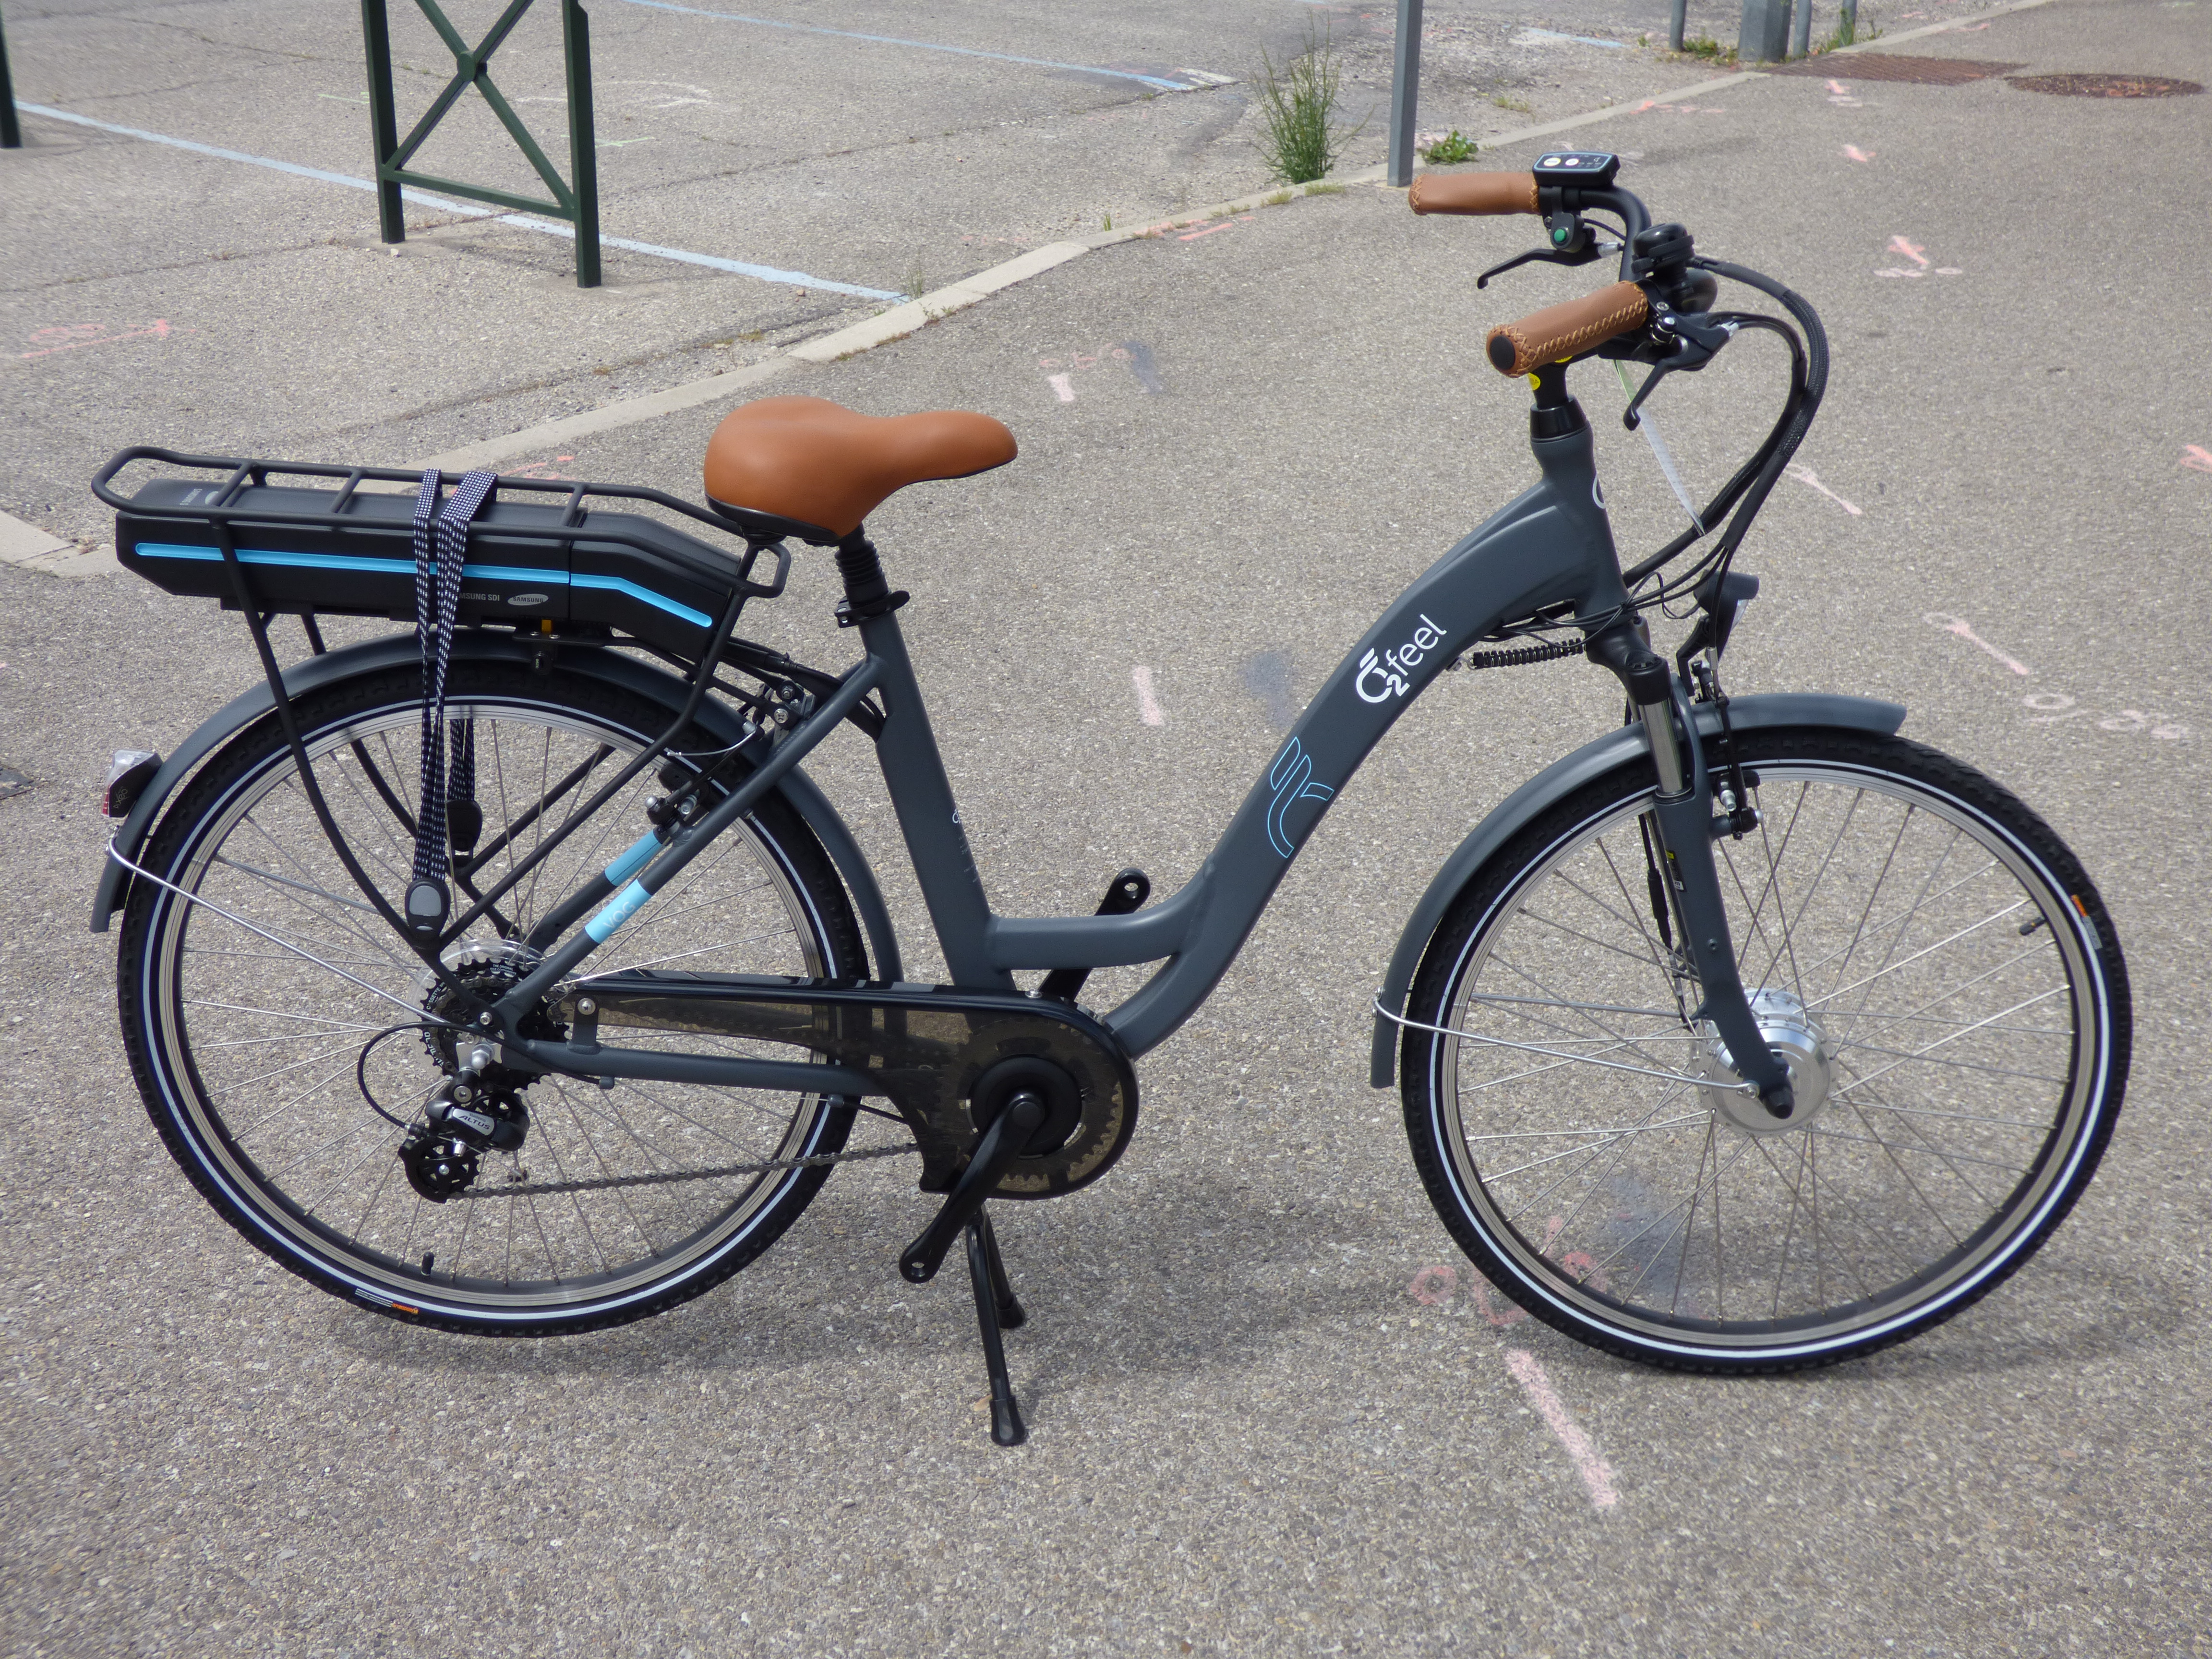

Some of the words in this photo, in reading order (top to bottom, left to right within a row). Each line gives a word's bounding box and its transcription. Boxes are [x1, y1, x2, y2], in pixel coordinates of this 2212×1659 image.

[459, 592, 486, 601] MSUNG
[603, 902, 636, 929] VOG
[458, 1115, 491, 1130] ALTUS
